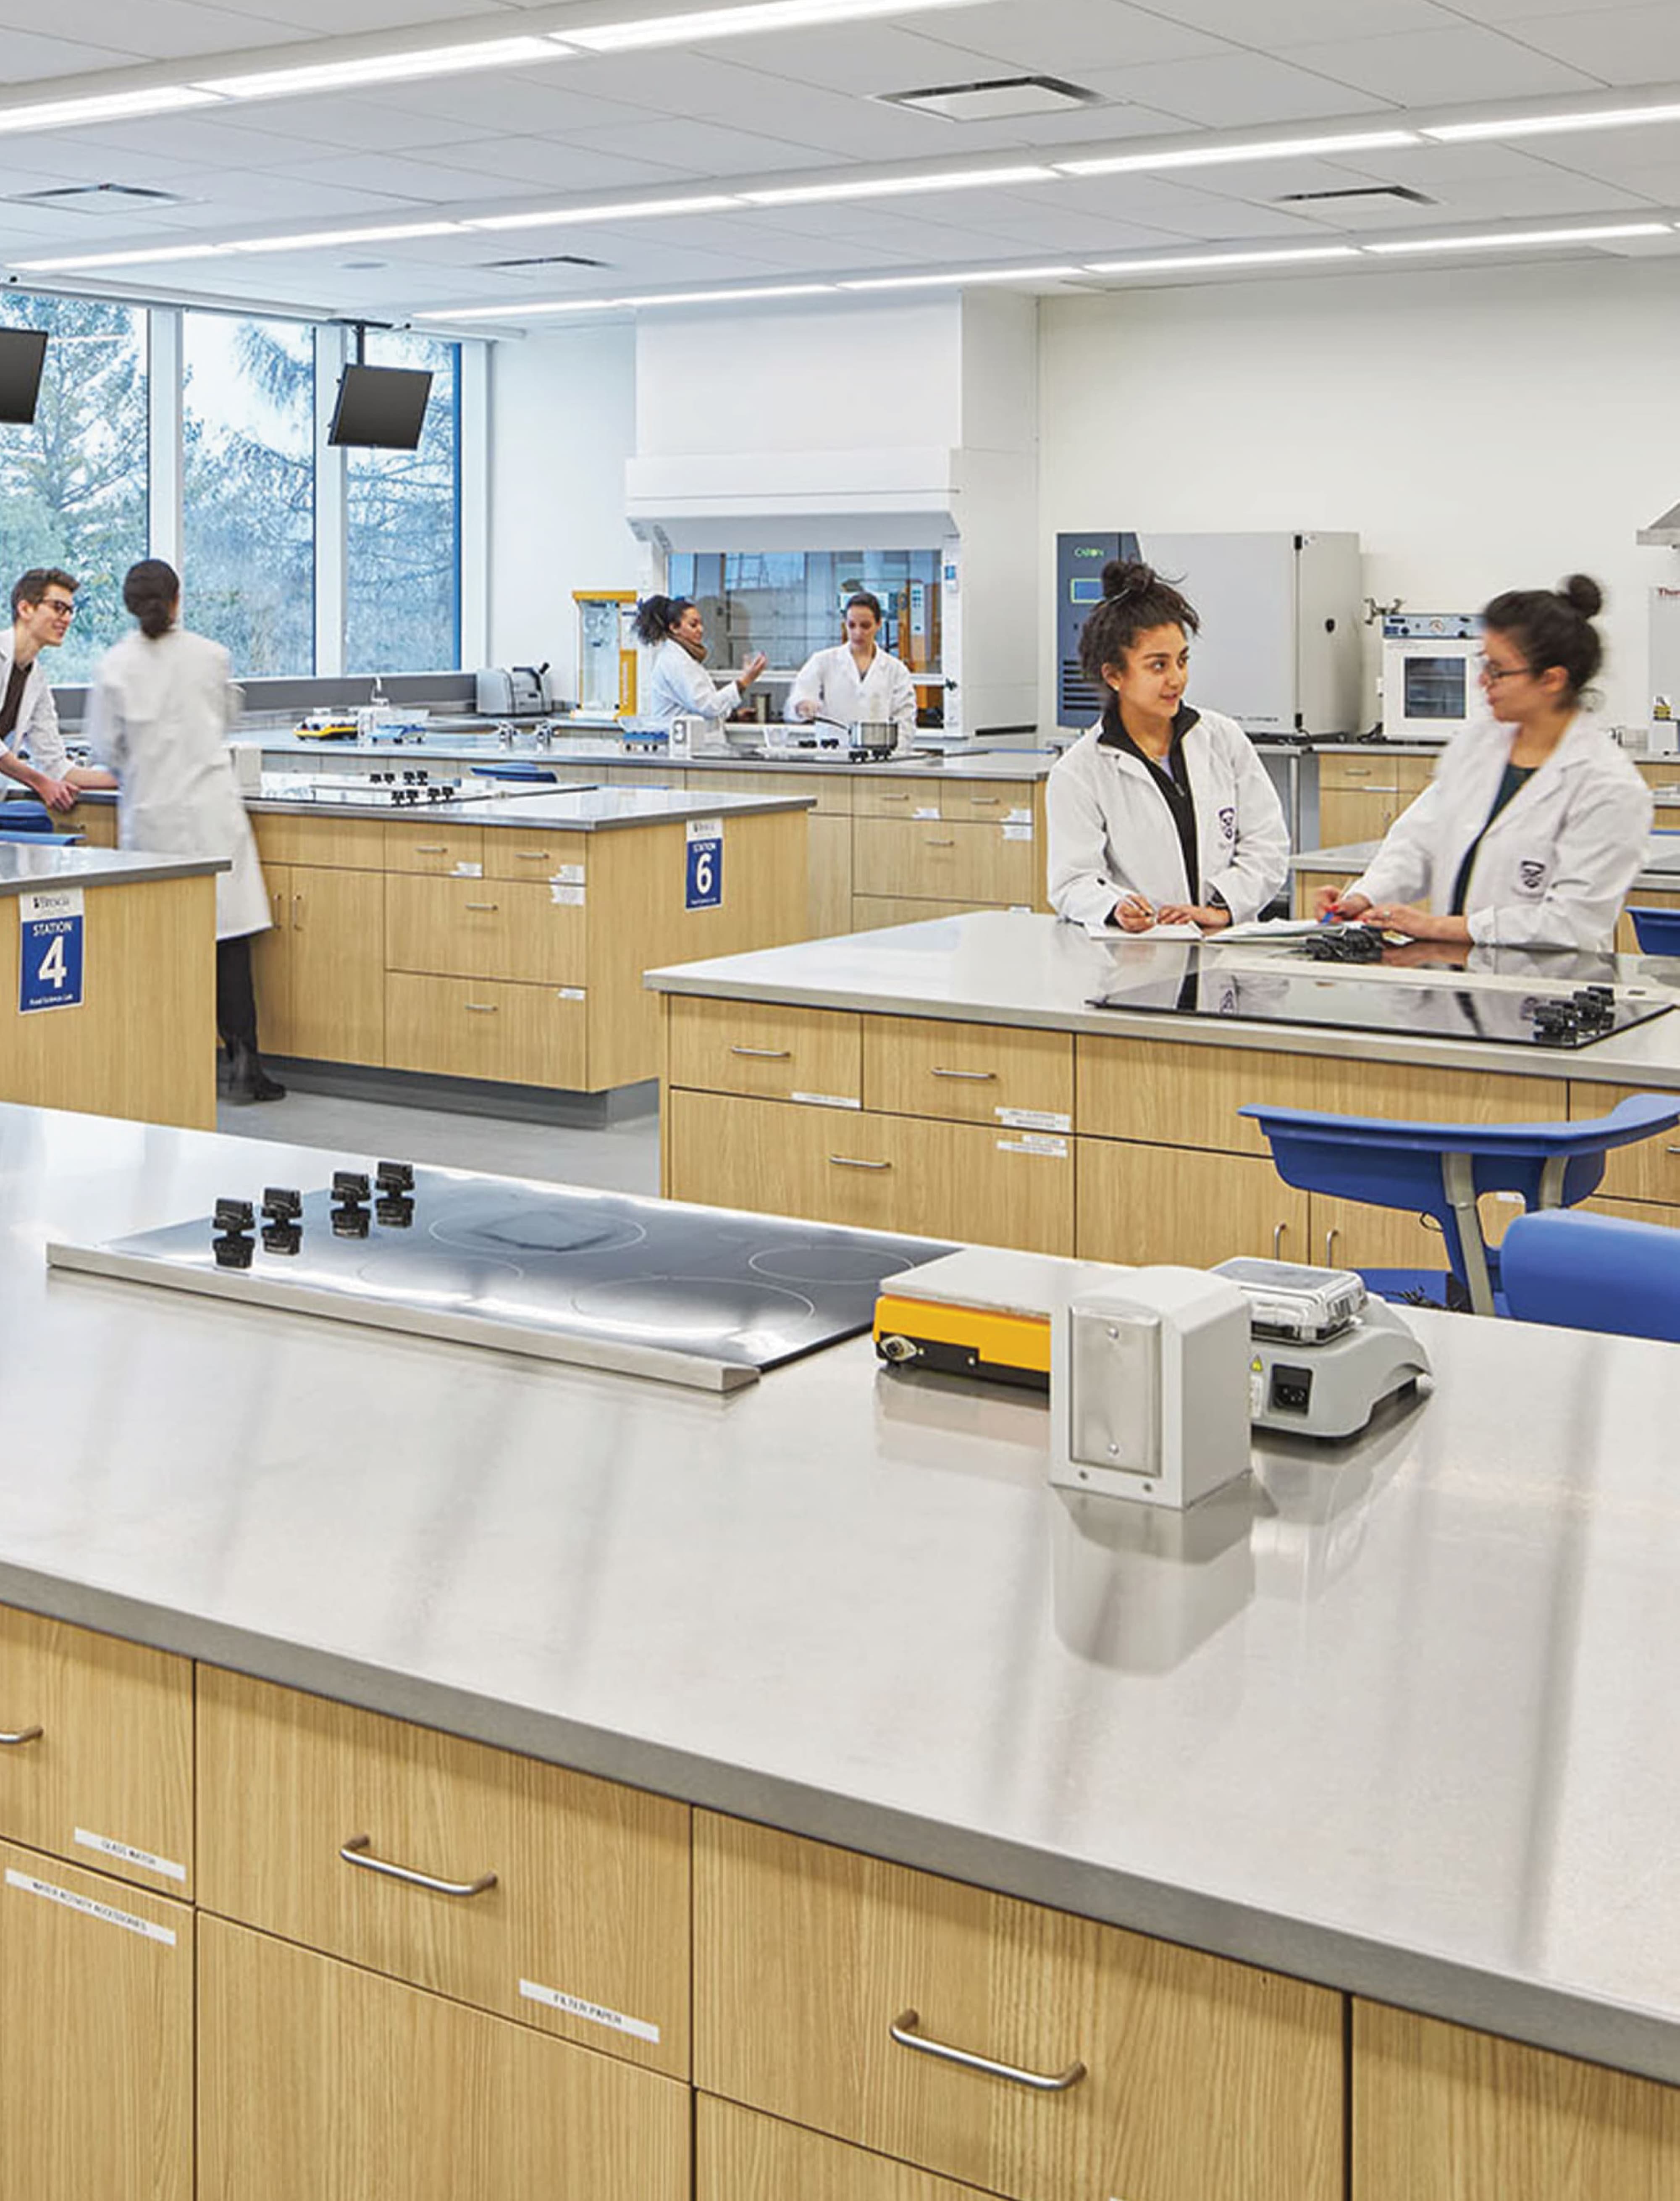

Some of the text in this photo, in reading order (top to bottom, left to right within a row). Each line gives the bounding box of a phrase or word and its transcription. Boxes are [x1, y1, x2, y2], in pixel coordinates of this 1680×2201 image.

[696, 853, 712, 894] 6
[33, 920, 73, 937] STATION
[39, 936, 66, 988] 4
[554, 1993, 622, 2024] FILTER PAPER
